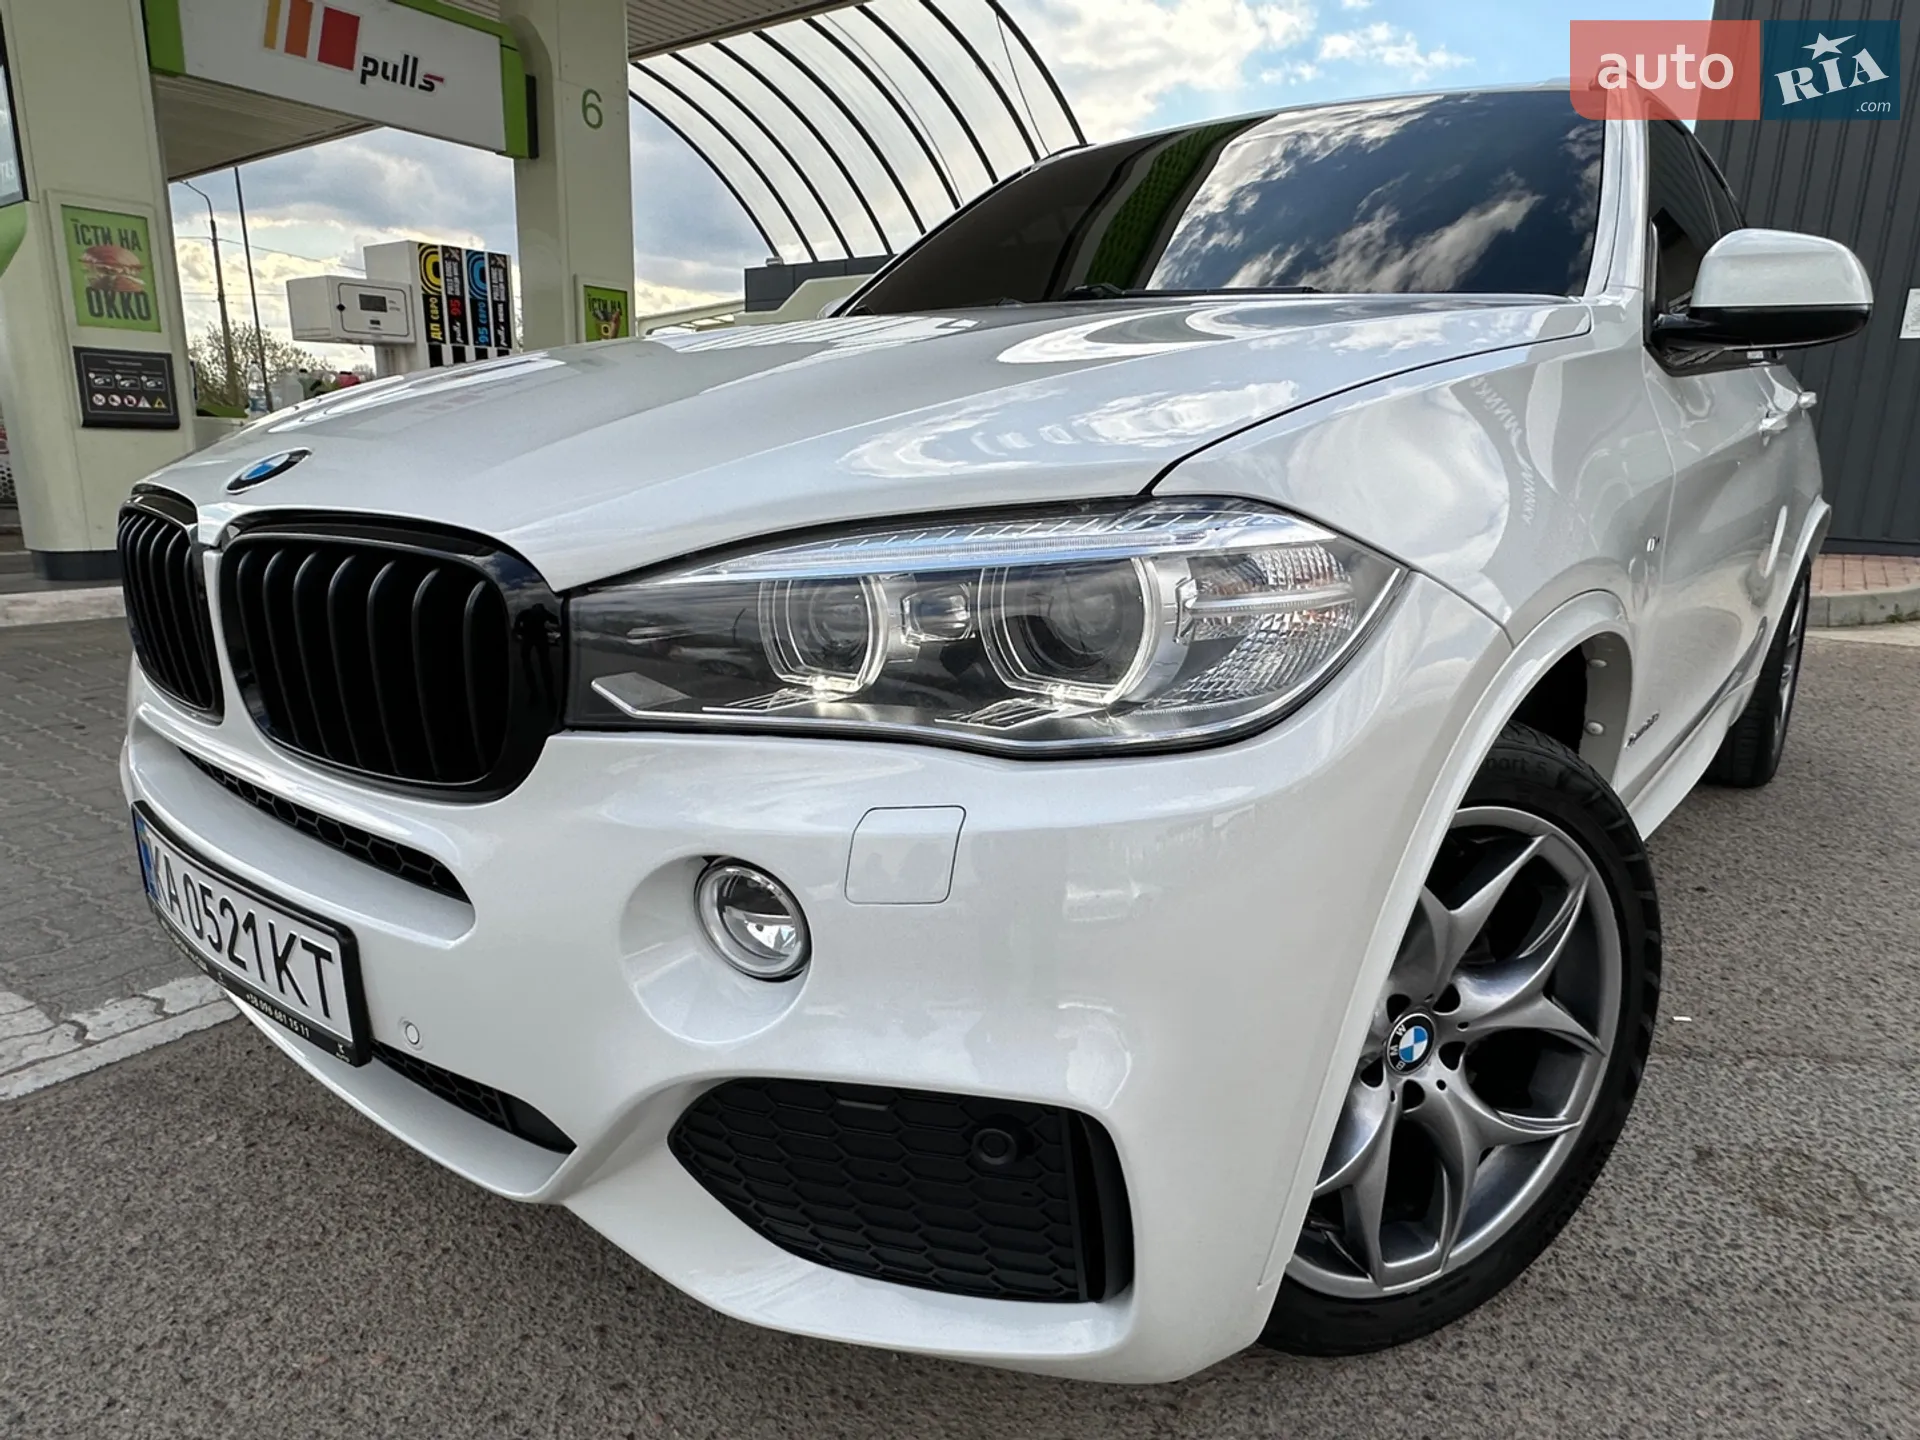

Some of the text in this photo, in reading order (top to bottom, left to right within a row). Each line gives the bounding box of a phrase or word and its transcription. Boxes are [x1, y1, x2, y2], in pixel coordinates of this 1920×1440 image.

[360, 54, 444, 92] pulls
[582, 89, 603, 130] 6
[70, 218, 143, 252] ЇСТИ НА
[450, 299, 461, 316] 95
[1389, 1023, 1407, 1071] BMW
